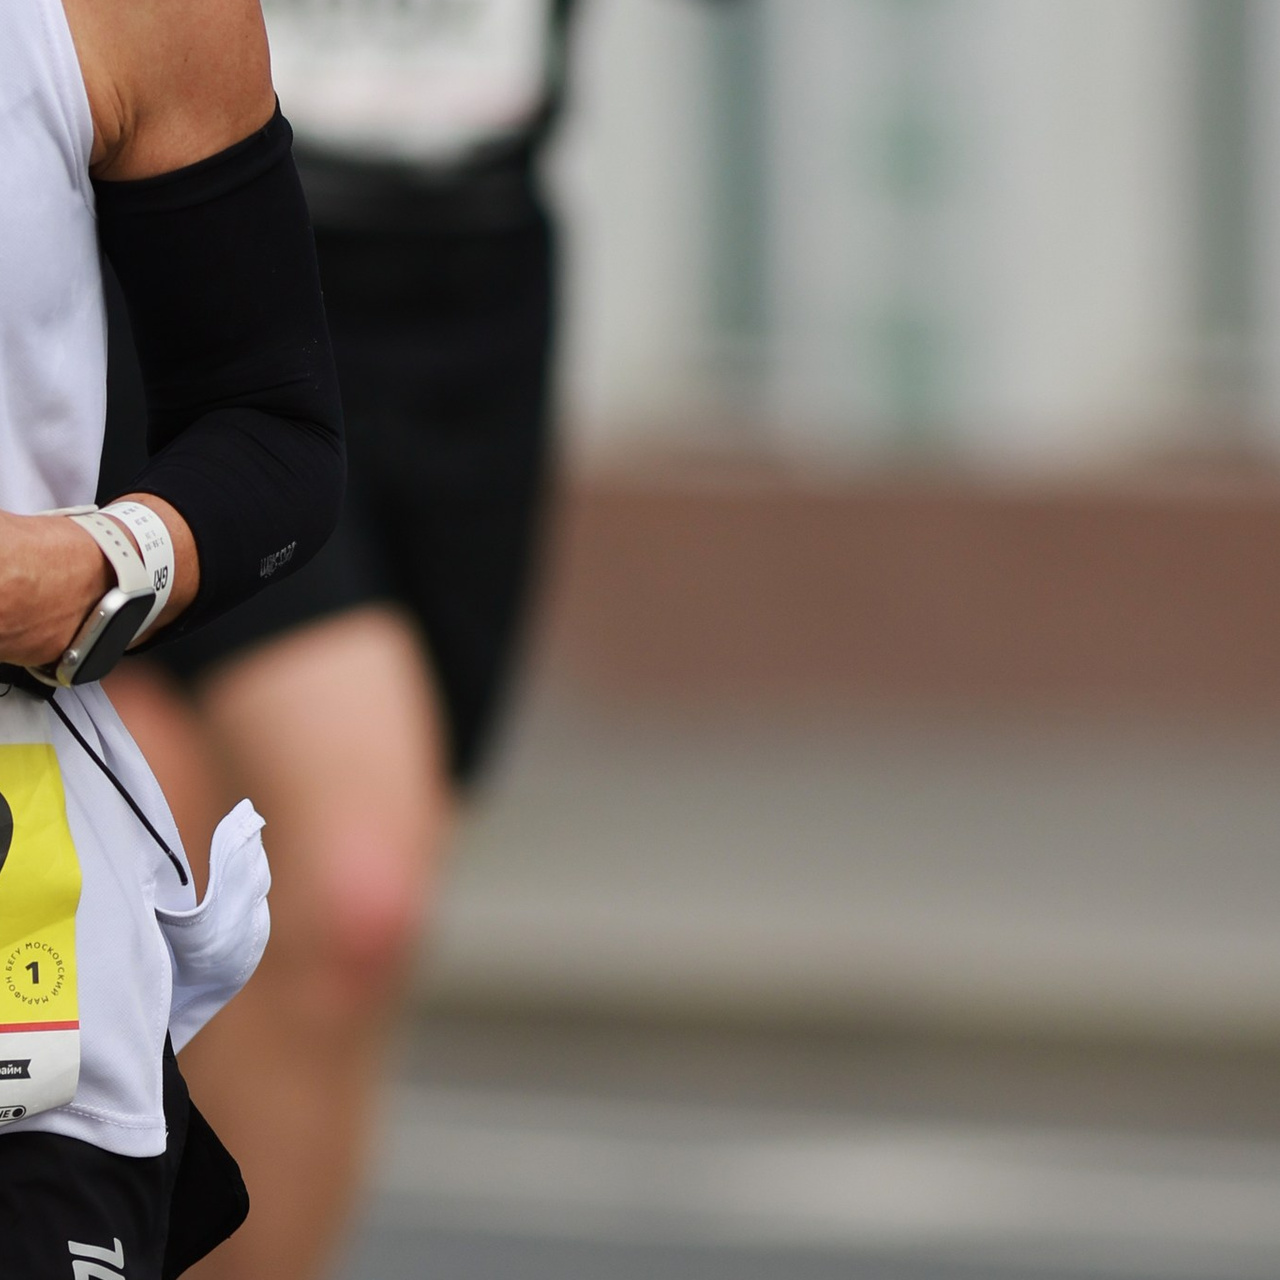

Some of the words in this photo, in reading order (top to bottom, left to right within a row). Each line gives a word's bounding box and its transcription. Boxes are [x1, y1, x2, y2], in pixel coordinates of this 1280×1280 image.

[5, 947, 21, 972] БЕГУ
[24, 961, 40, 985] 1
[5, 976, 50, 1005] МАРАФОН
